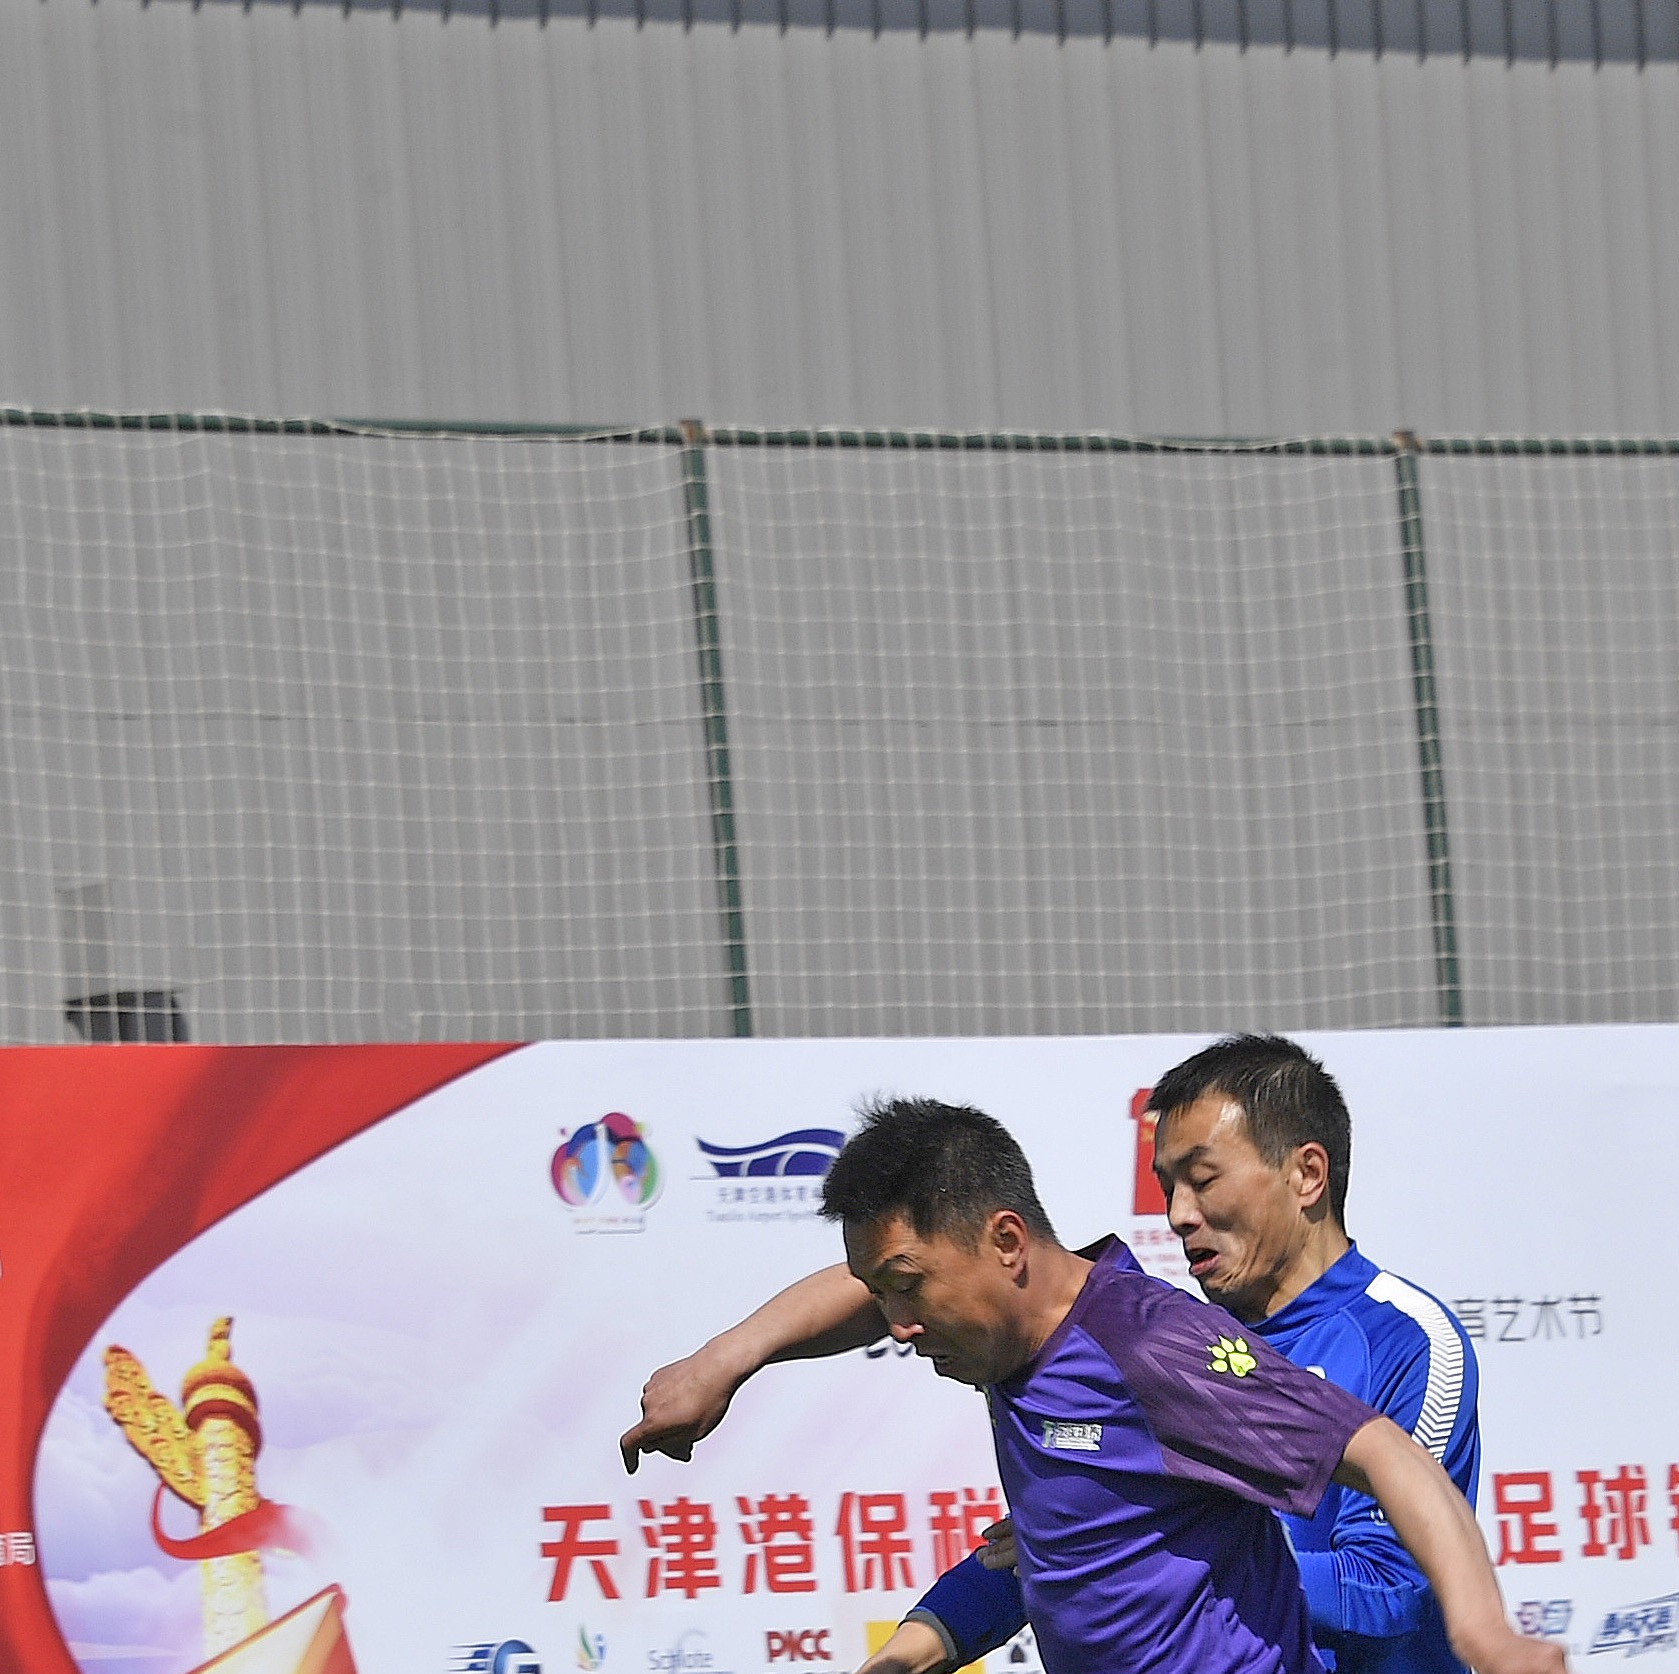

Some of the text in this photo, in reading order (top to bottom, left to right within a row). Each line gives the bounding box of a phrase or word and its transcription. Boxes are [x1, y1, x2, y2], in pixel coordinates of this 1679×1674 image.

[540, 1487, 1001, 1602] 天津港保税
[766, 1629, 833, 1663] PICC
